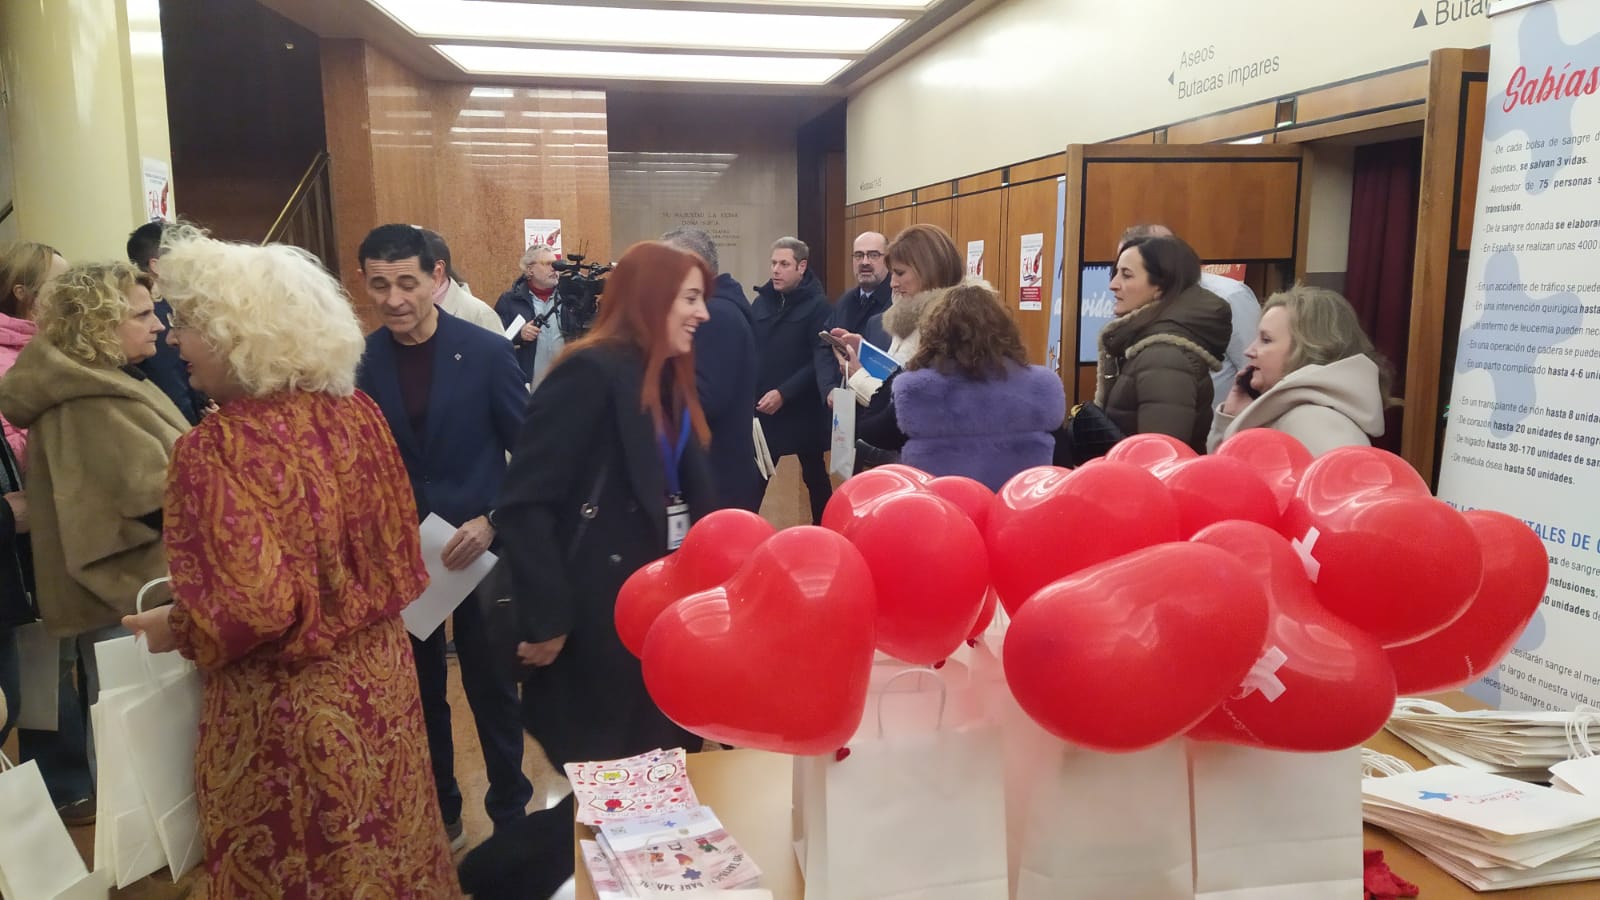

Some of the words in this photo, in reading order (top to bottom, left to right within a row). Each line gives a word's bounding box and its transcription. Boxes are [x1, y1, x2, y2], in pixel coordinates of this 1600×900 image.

[1180, 44, 1215, 69] Aseos
[1178, 73, 1224, 99] Butacas
[1228, 55, 1280, 86] impares
[1503, 62, 1600, 113] Sabías
[1506, 142, 1522, 153] cada
[1525, 138, 1545, 150] bolsa
[1548, 137, 1558, 147] de
[1561, 134, 1591, 146] sangre
[1520, 162, 1528, 170] se
[1529, 158, 1555, 170] salvan
[1556, 157, 1562, 167] 3
[1564, 154, 1589, 166] vidas.
[1525, 181, 1534, 191] de
[1538, 179, 1549, 189] 75
[1553, 176, 1593, 188] personas
[1501, 222, 1524, 234] sangre
[1525, 220, 1554, 231] donada
[1555, 220, 1564, 229] se
[1491, 241, 1515, 253] España
[1516, 243, 1524, 252] se
[1525, 241, 1555, 252] realizan
[1557, 242, 1576, 251] unas
[1577, 239, 1598, 250] 4000
[1495, 282, 1527, 292] accidente
[1529, 282, 1539, 292] de
[1540, 281, 1565, 293] tráfico
[1567, 284, 1575, 293] se
[1495, 301, 1540, 313] intervención
[1579, 303, 1600, 315] hasta
[1509, 322, 1519, 332] de
[1520, 323, 1555, 334] leucemia
[1555, 325, 1583, 336] pueden
[1489, 340, 1525, 353] operación
[1526, 343, 1536, 353] de
[1537, 345, 1563, 356] cadera
[1563, 347, 1572, 356] se
[1483, 361, 1501, 371] parto
[1502, 362, 1546, 375] complicado
[1547, 366, 1568, 377] hasta
[1569, 368, 1584, 378] 4-6
[1478, 399, 1517, 412] transplante
[1518, 403, 1528, 414] de
[1545, 407, 1567, 419] hasta
[1568, 410, 1574, 420] 8
[1467, 417, 1492, 428] corazón
[1493, 421, 1514, 432] hasta
[1515, 424, 1526, 434] 20
[1527, 426, 1562, 440] unidades
[1563, 431, 1573, 441] de
[1486, 439, 1507, 451] hasta
[1508, 442, 1536, 456] 30-170
[1537, 450, 1572, 464] unidades
[1573, 455, 1584, 465] de
[1504, 462, 1525, 475] hasta
[1526, 466, 1536, 477] 50
[1537, 470, 1575, 485] unidades.
[1571, 531, 1591, 551] DE
[1560, 557, 1570, 568] de
[1551, 599, 1591, 619] unidades
[1545, 659, 1573, 677] sangre
[1573, 669, 1582, 680] al
[1507, 664, 1526, 680] largo
[1527, 673, 1537, 684] de
[1538, 679, 1569, 697] nuestra
[1570, 690, 1588, 705] vida
[1519, 690, 1545, 708] sangre
[1546, 702, 1552, 711] o
